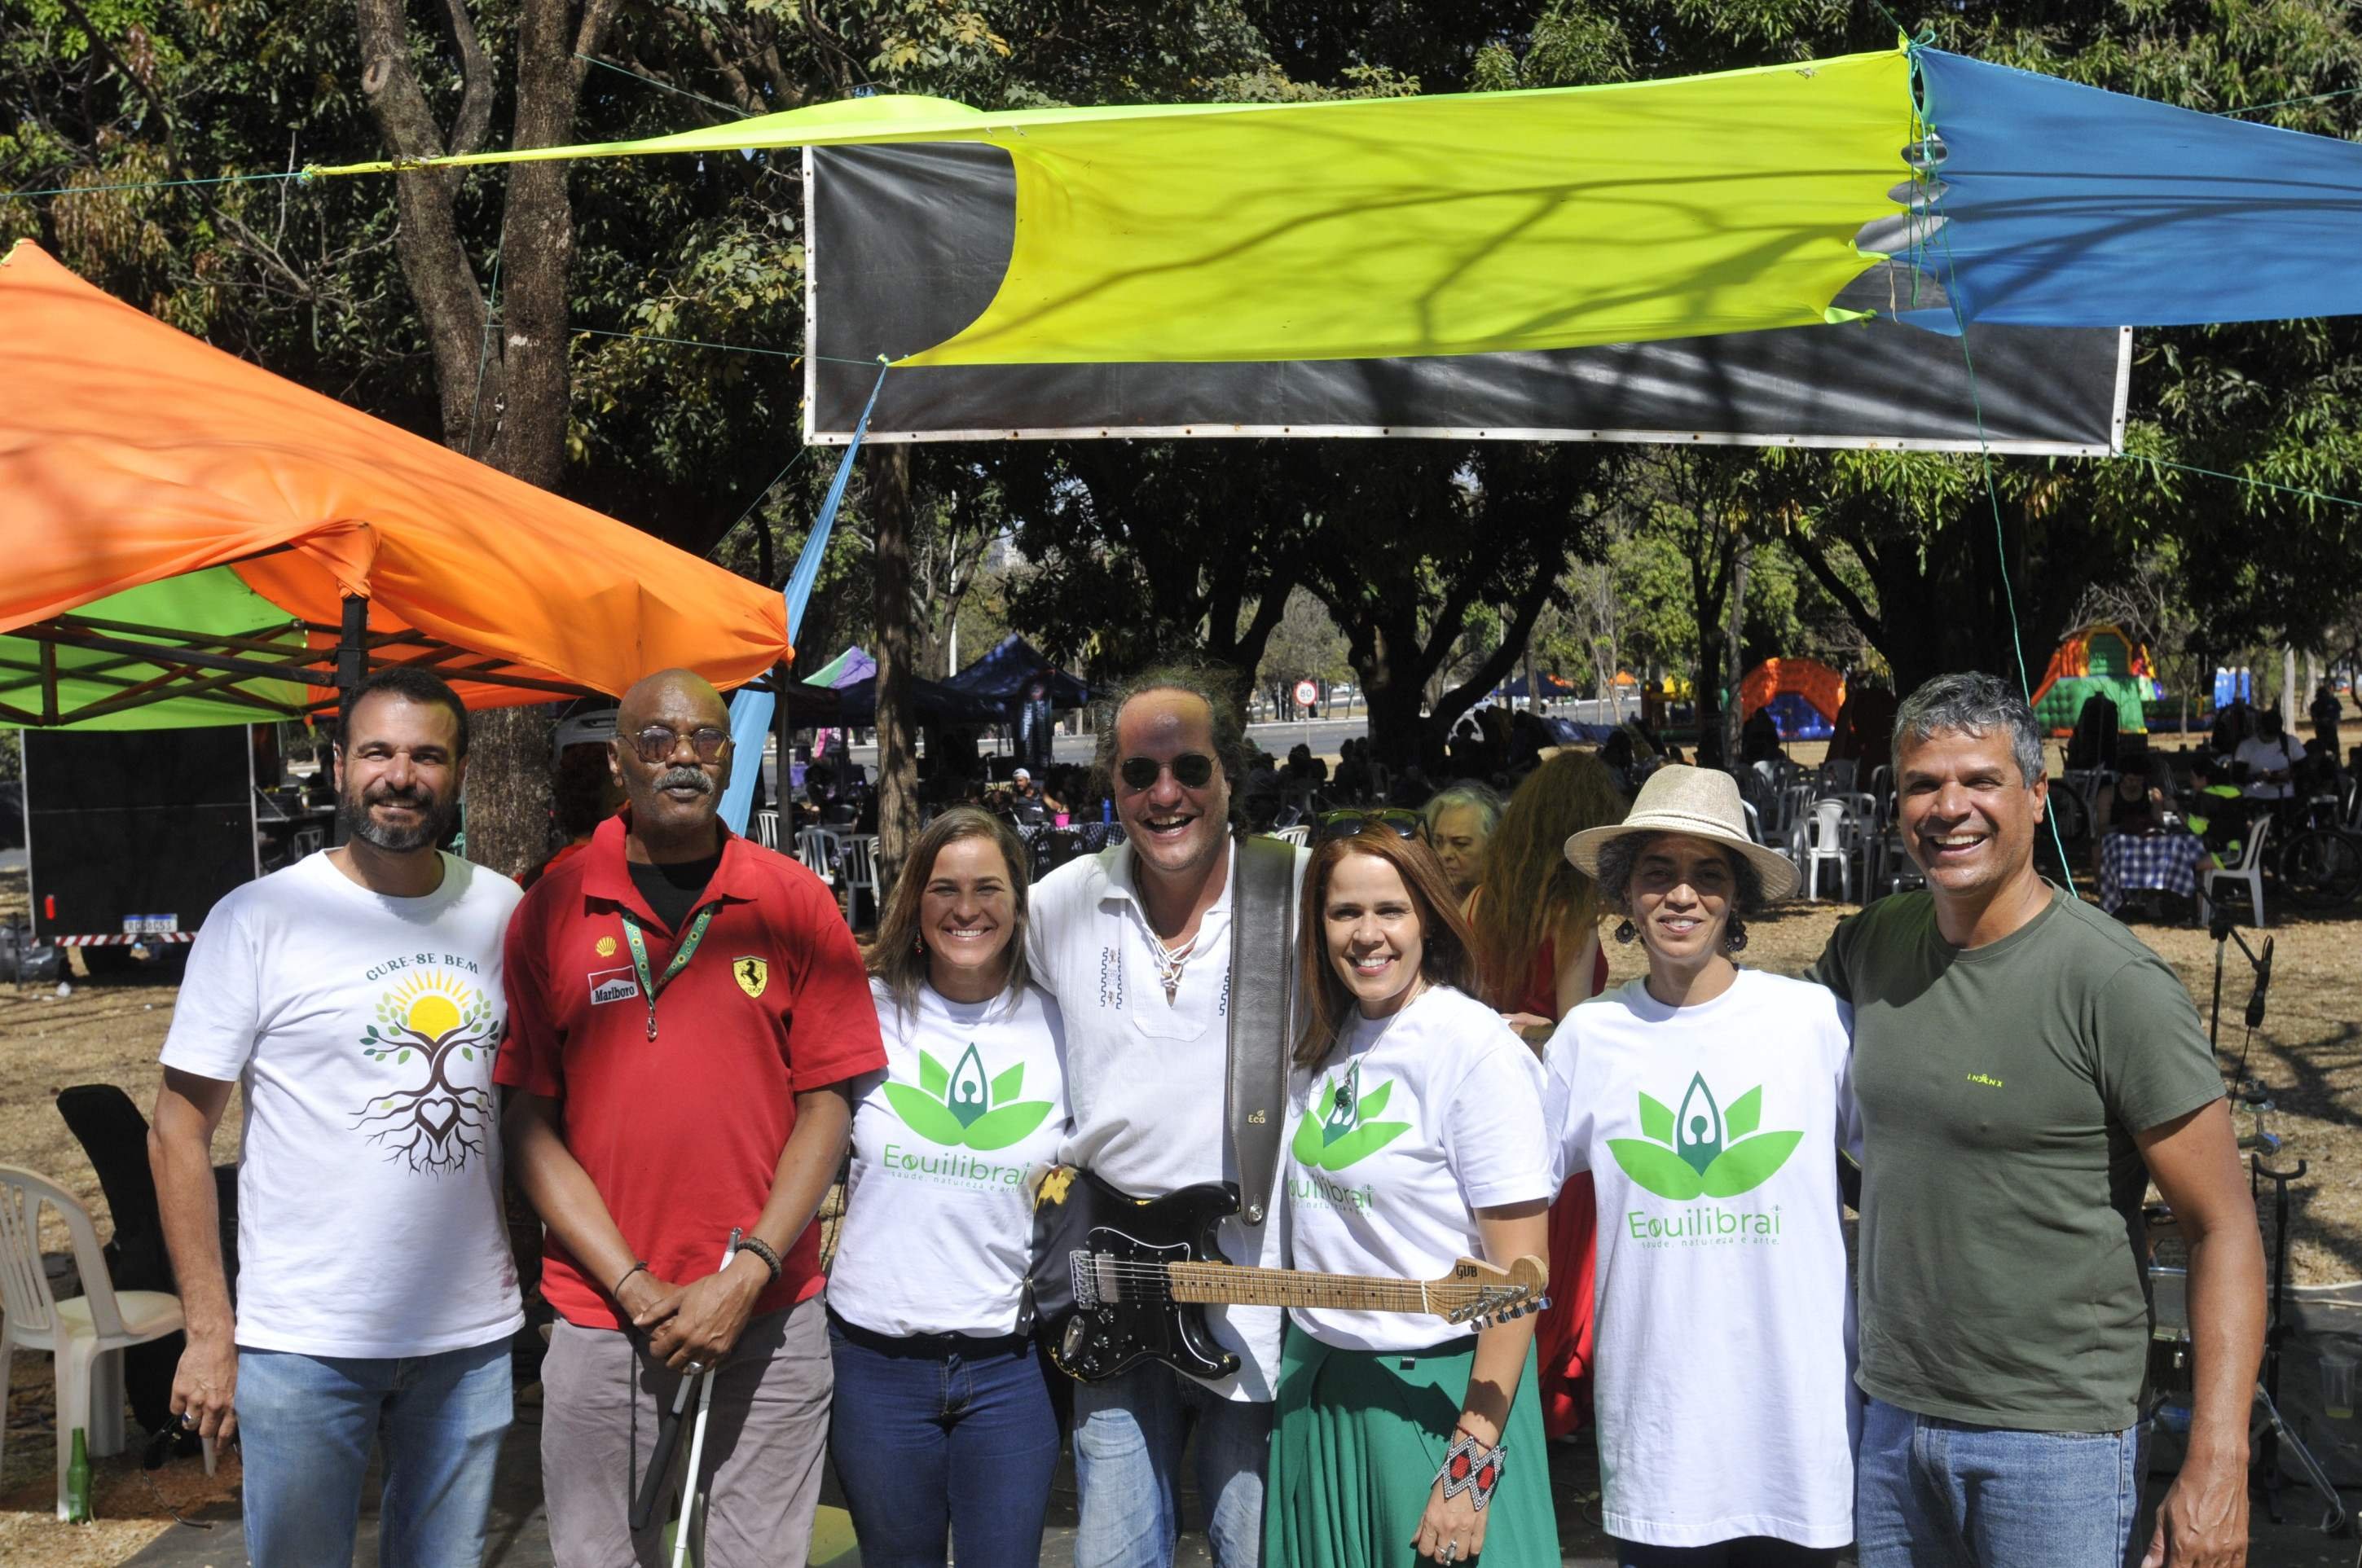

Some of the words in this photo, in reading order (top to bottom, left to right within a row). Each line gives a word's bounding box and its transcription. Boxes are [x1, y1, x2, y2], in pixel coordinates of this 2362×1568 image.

[1300, 689, 1312, 697] 80
[366, 953, 437, 981] CURE-SE
[445, 955, 478, 974] BEM
[595, 986, 635, 1003] Marlboro
